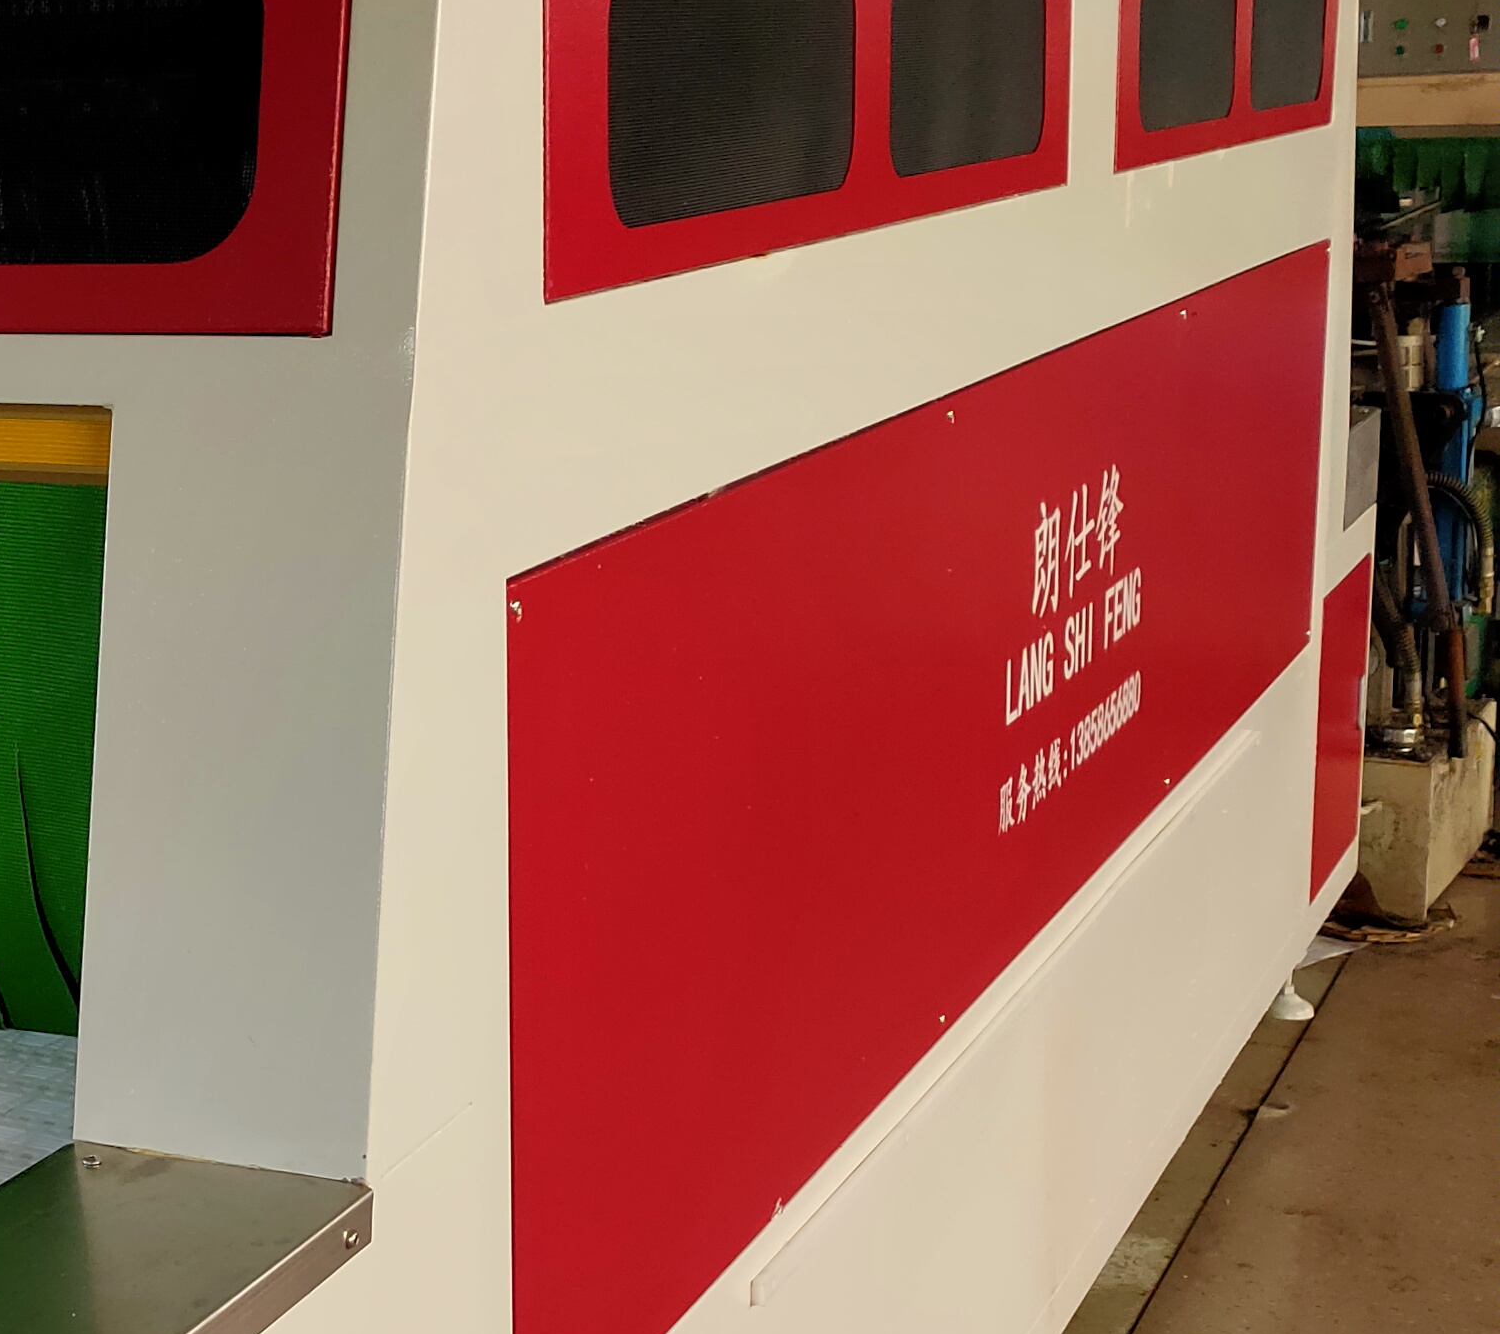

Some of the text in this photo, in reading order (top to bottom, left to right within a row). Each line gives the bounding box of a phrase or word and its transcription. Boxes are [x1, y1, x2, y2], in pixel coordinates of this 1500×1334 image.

[1031, 463, 1125, 618] 朗仕锋
[1005, 567, 1142, 726] LANG SHI FENG
